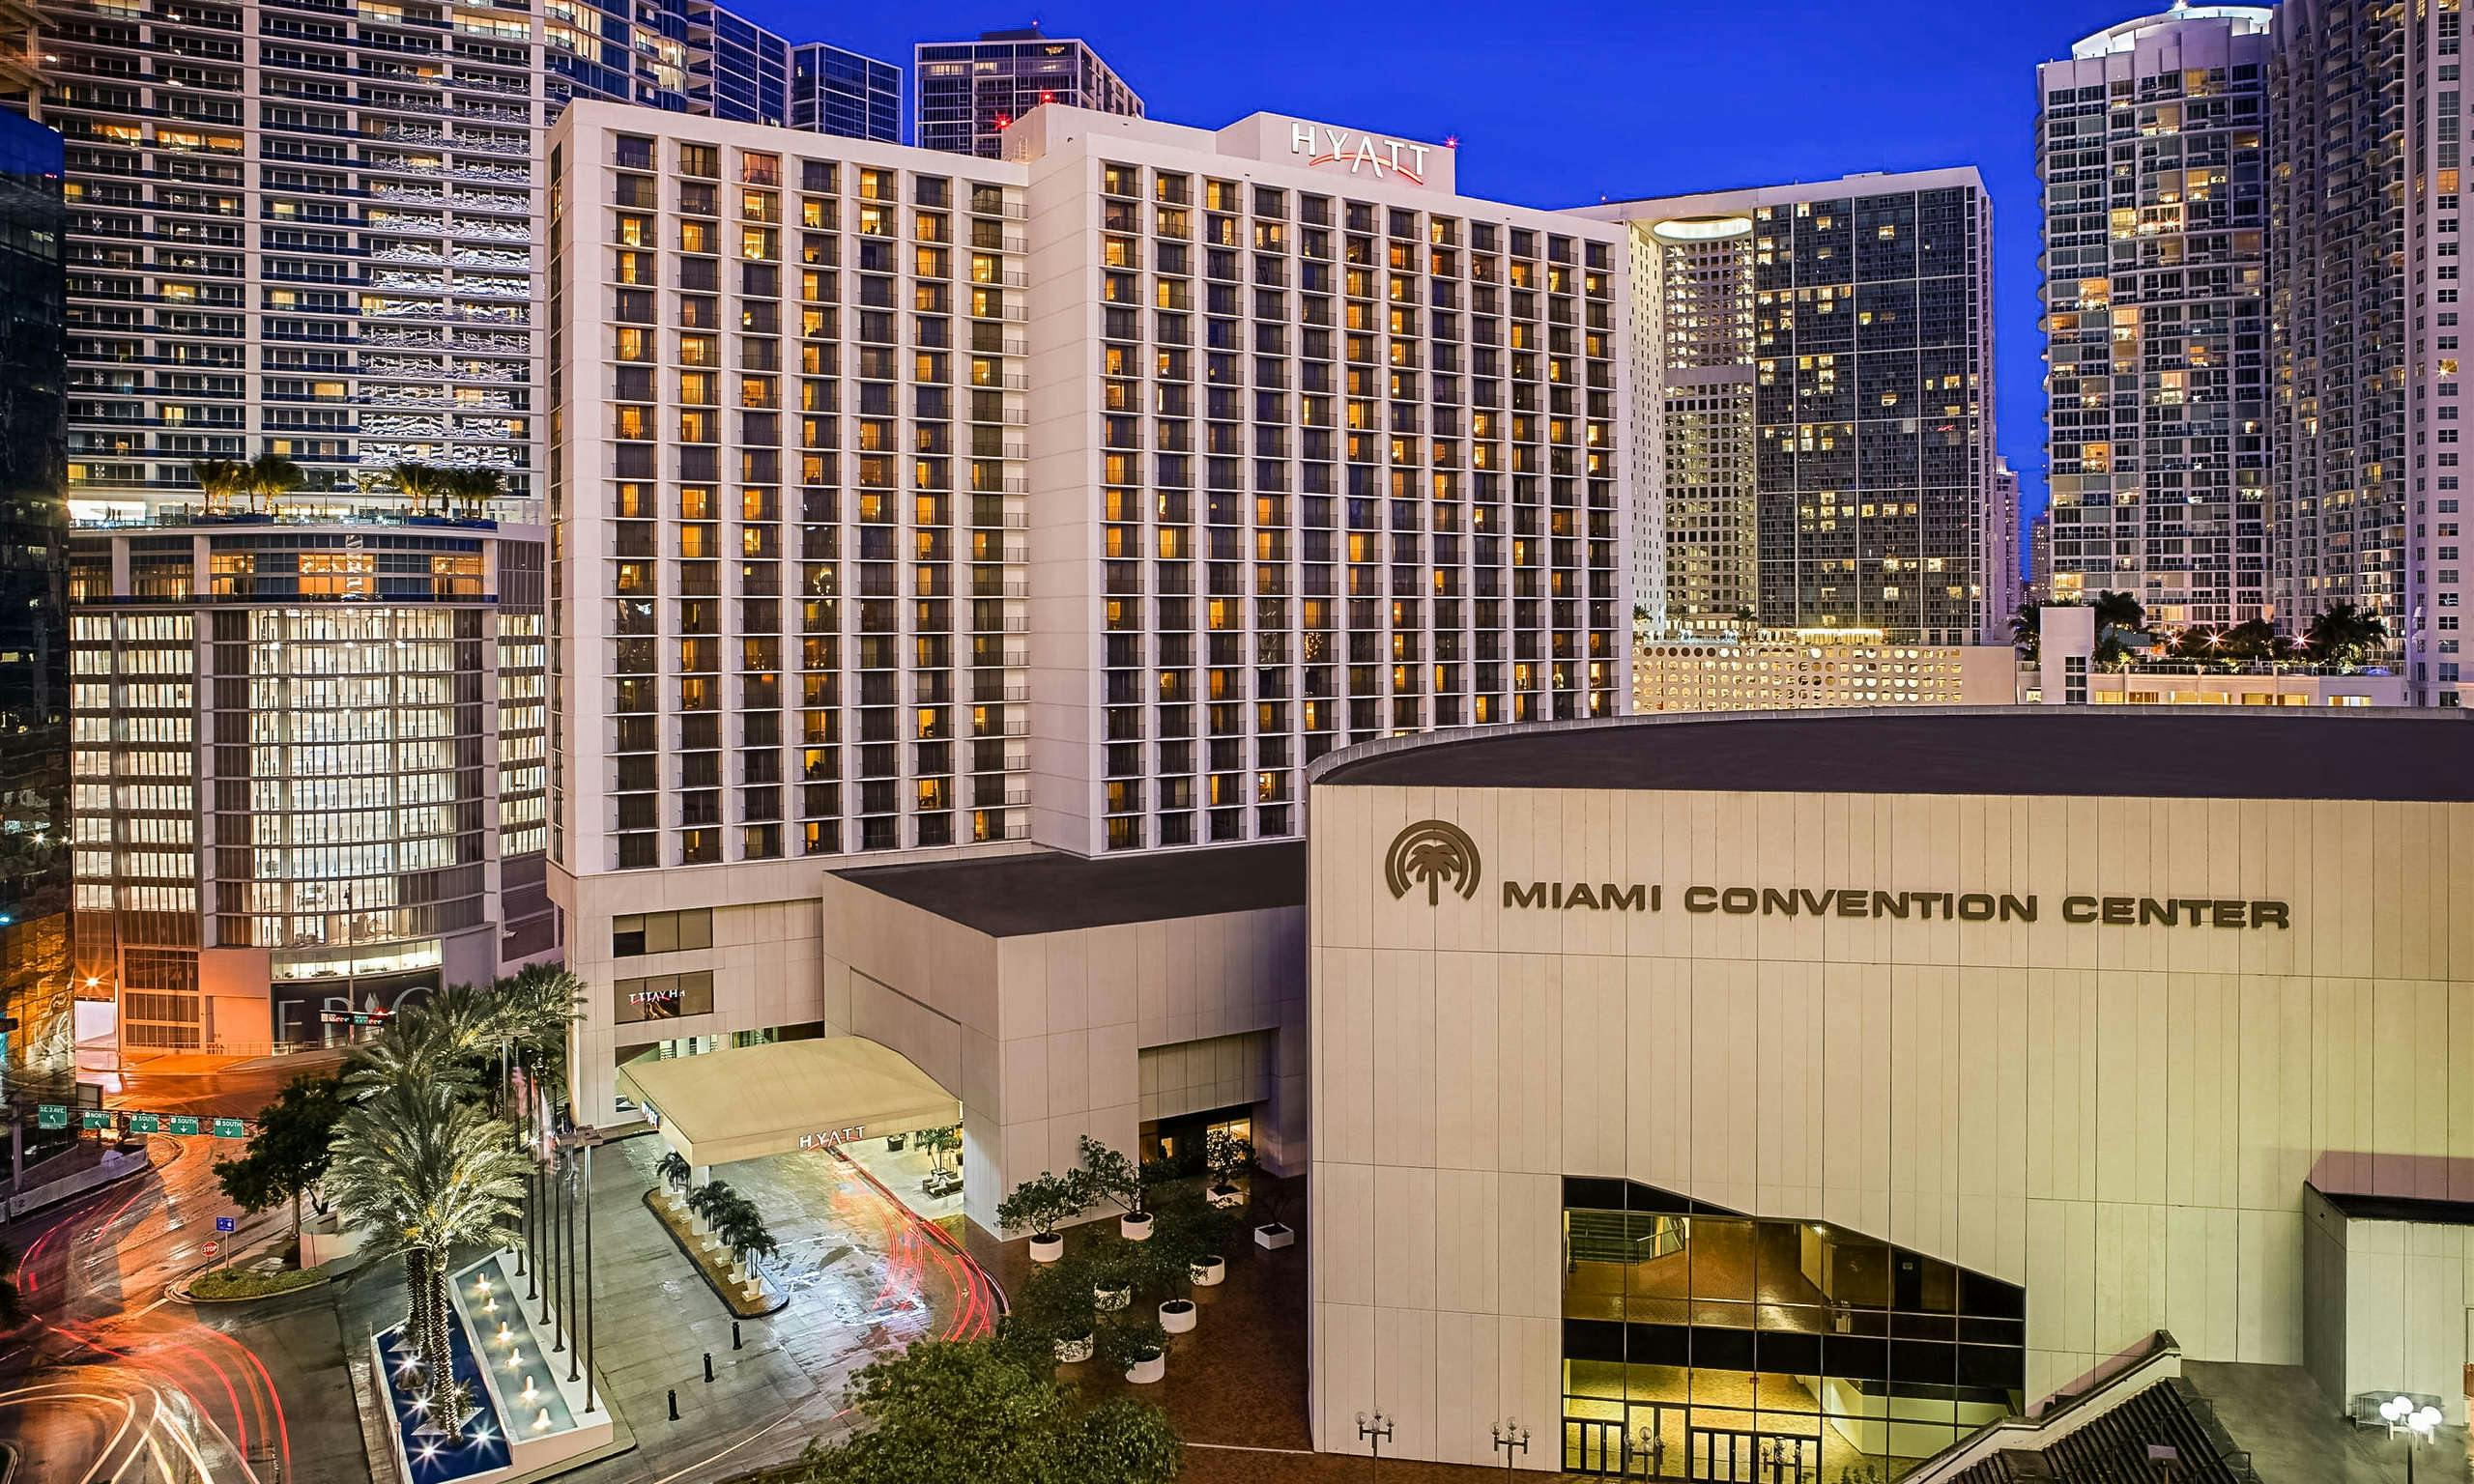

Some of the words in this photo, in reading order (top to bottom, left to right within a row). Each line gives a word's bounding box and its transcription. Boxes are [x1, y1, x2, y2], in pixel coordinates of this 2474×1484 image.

[1291, 122, 1430, 179] HYATT
[1504, 880, 1662, 911] MIAMI
[1684, 885, 2038, 922] CONVENTION
[2061, 895, 2290, 929] CENTER
[799, 1126, 866, 1148] HYATT
